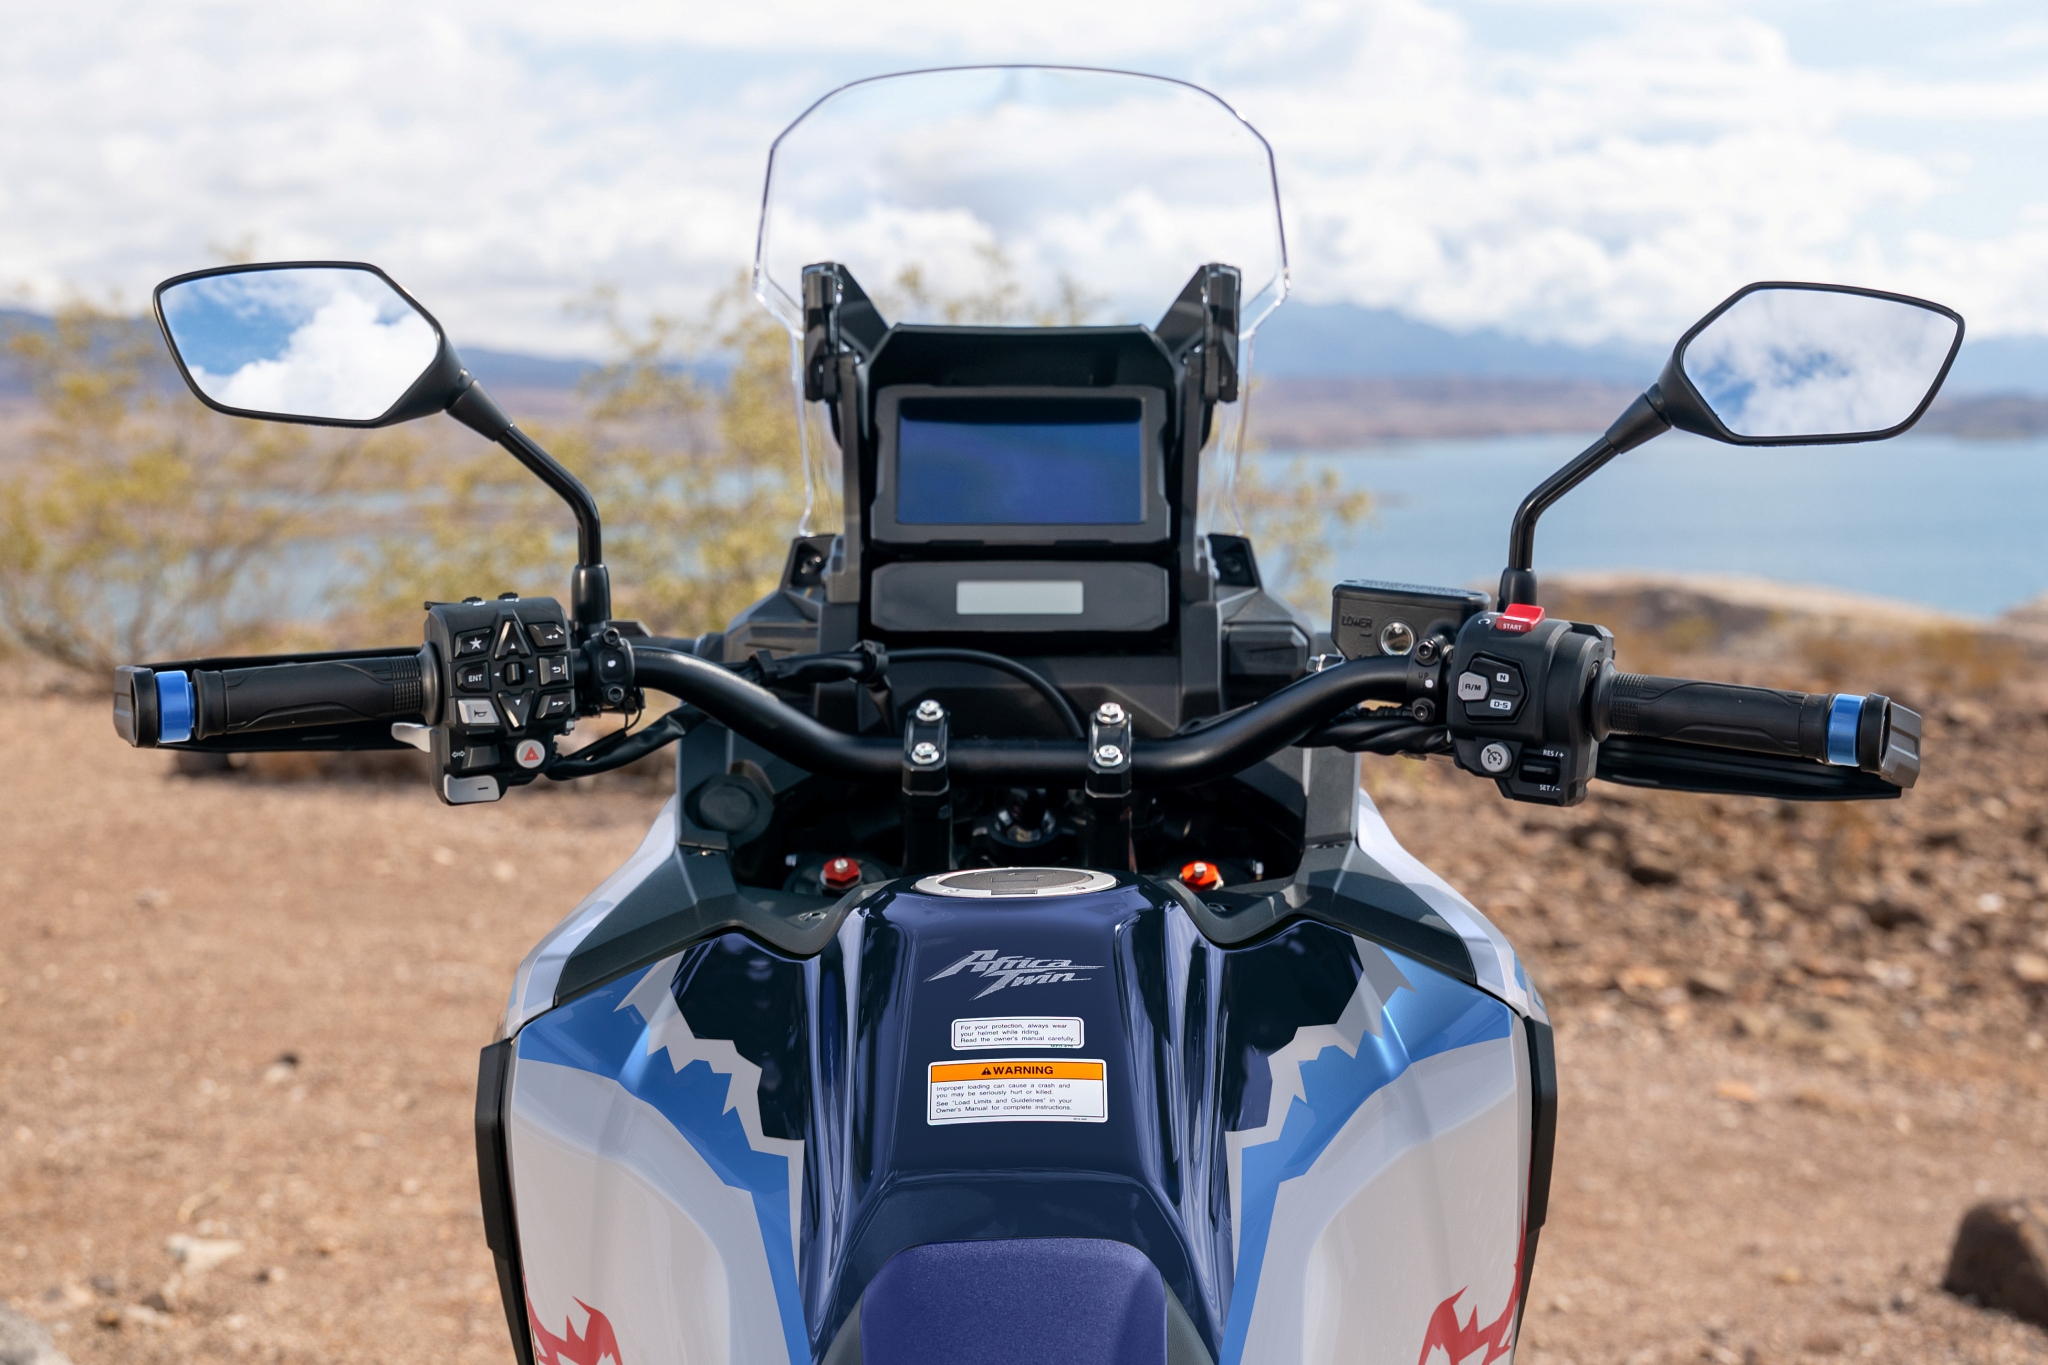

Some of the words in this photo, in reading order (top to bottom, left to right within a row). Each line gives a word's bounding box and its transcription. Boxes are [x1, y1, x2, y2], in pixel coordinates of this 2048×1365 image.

[1341, 615, 1373, 628] LOWER
[1502, 623, 1523, 631] START
[468, 674, 482, 682] ENT
[1418, 671, 1429, 679] UP
[1465, 683, 1481, 691] R/M
[1493, 701, 1508, 709] D-S
[923, 949, 1105, 982] Africa
[969, 967, 1092, 1001] Twin
[993, 1066, 1054, 1075] WARNING
